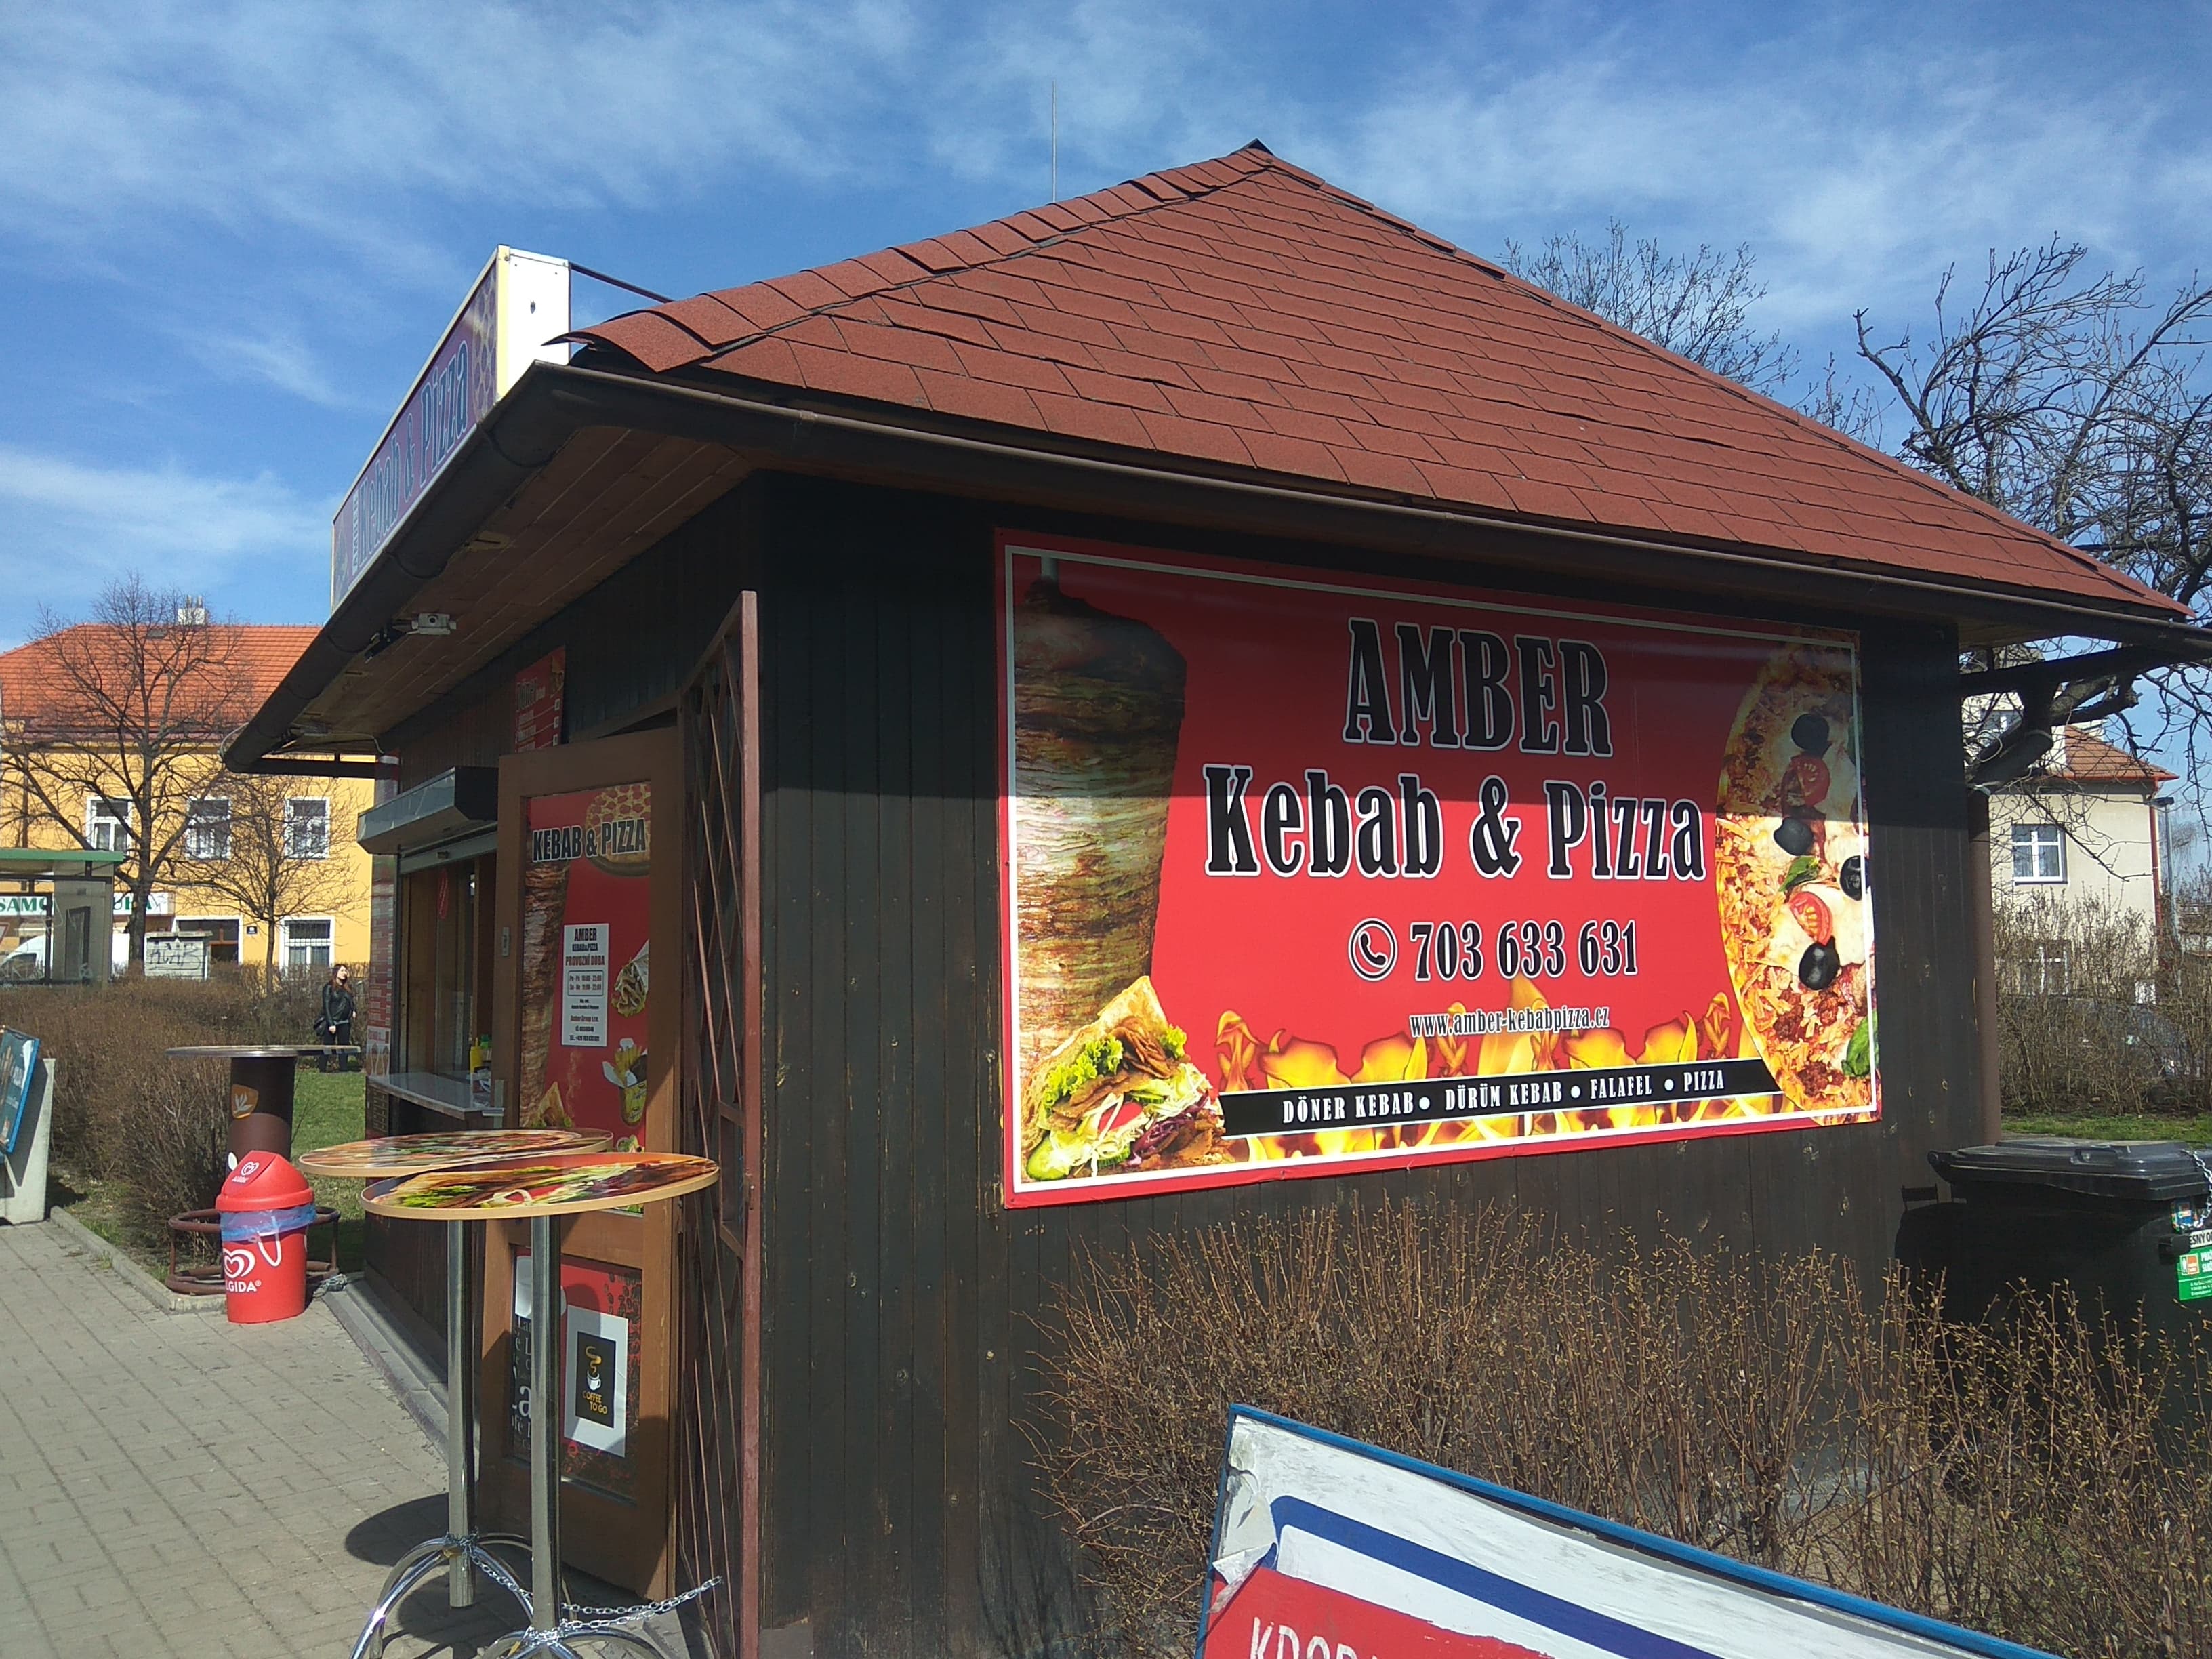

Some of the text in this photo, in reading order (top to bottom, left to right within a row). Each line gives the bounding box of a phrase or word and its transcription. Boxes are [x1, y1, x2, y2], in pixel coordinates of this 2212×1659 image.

[359, 340, 468, 567] Kebab & Pizza
[1343, 617, 1614, 757] AMBER
[532, 818, 647, 863] KEBAB & PIZZA
[1202, 763, 1706, 881] Kebab & Pizza
[574, 928, 597, 941] AMBER
[1410, 920, 1638, 981] 703 633 631
[1409, 1004, 1610, 1038] www.amber-kebabpizza.cz
[1283, 1069, 1725, 1124] DÖNER KEBAB DÜRÜM KEBAB FALAFEL PIZZA
[582, 1390, 602, 1404] COFFEE
[590, 1401, 608, 1415] TO GO
